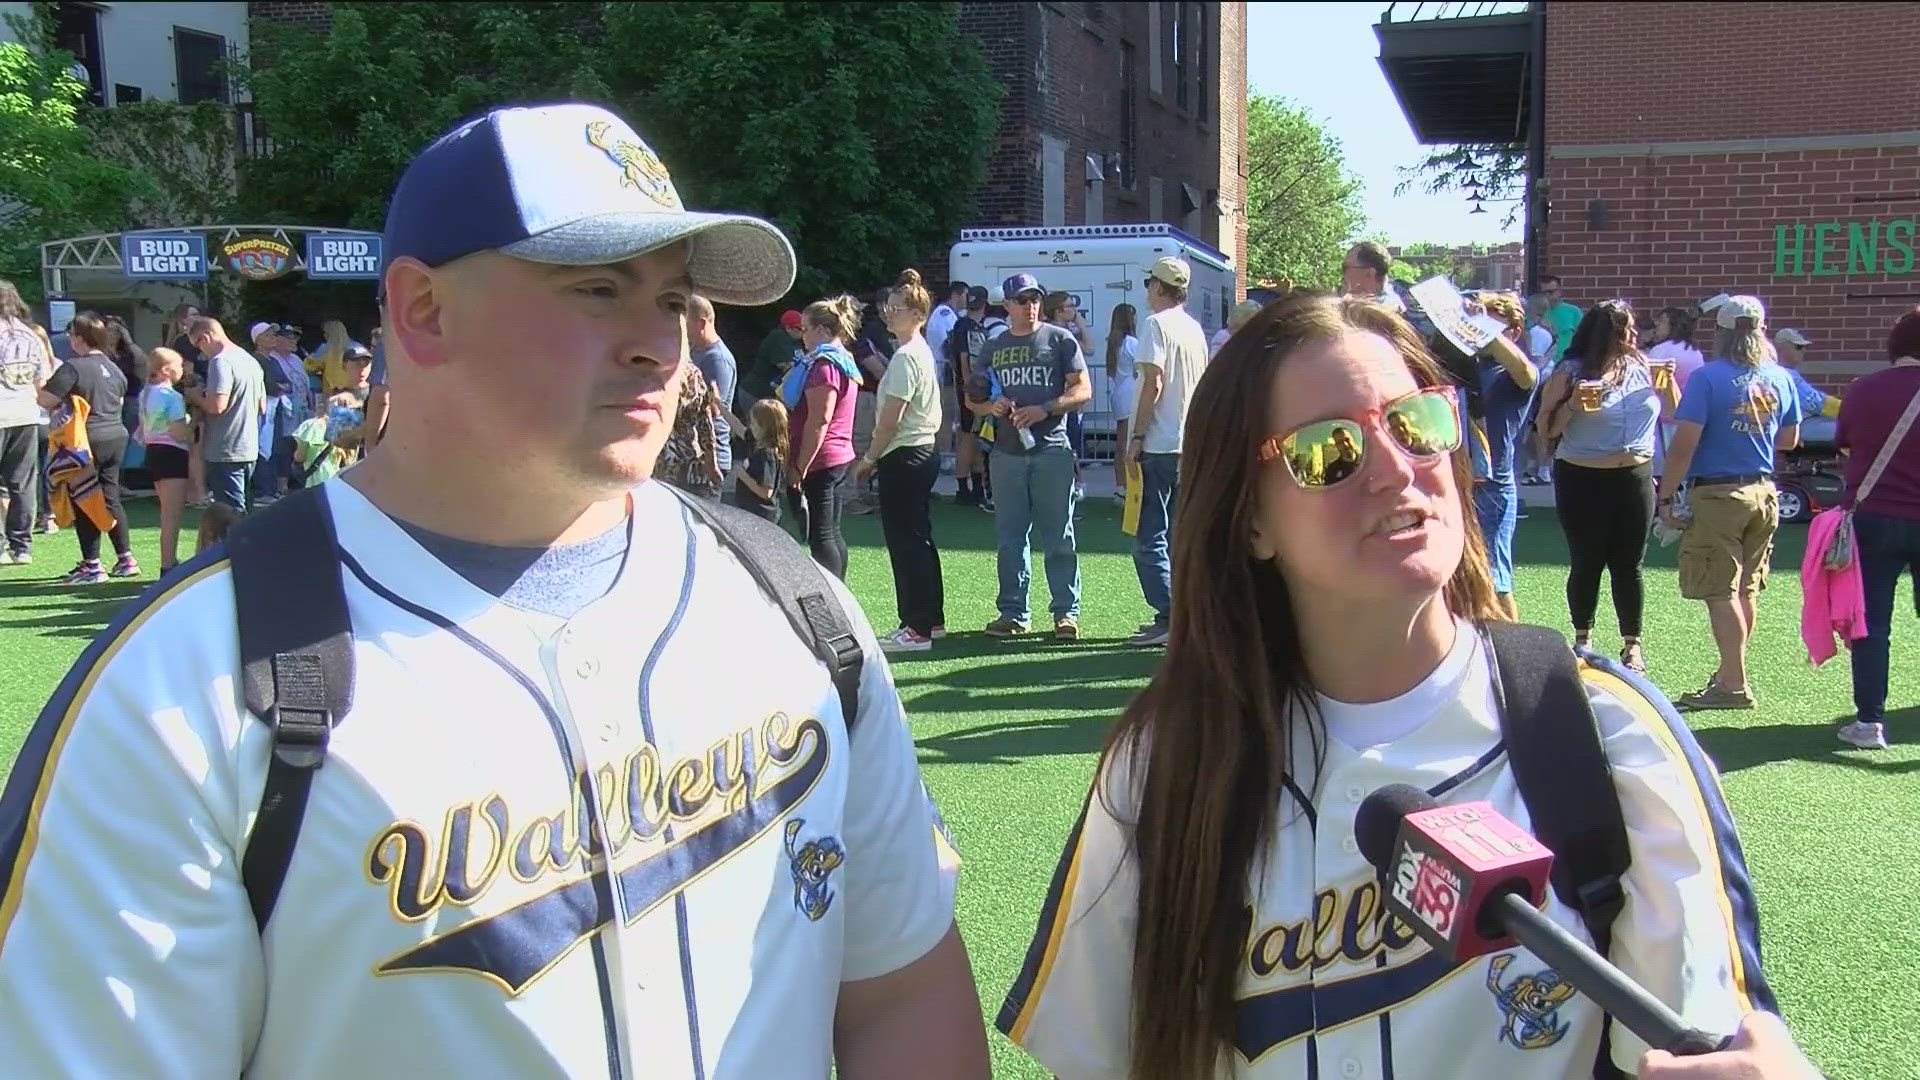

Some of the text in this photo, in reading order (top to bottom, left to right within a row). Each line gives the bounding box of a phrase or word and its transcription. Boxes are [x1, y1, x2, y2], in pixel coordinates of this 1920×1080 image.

[139, 240, 190, 256] BUD
[322, 241, 368, 257] BUD
[1774, 220, 1916, 277] HENS
[132, 256, 199, 272] LIGHT
[315, 257, 377, 272] LIGHT
[997, 365, 1054, 387] OCKEY.
[368, 711, 829, 923] Walleye
[1391, 840, 1425, 908] FOX
